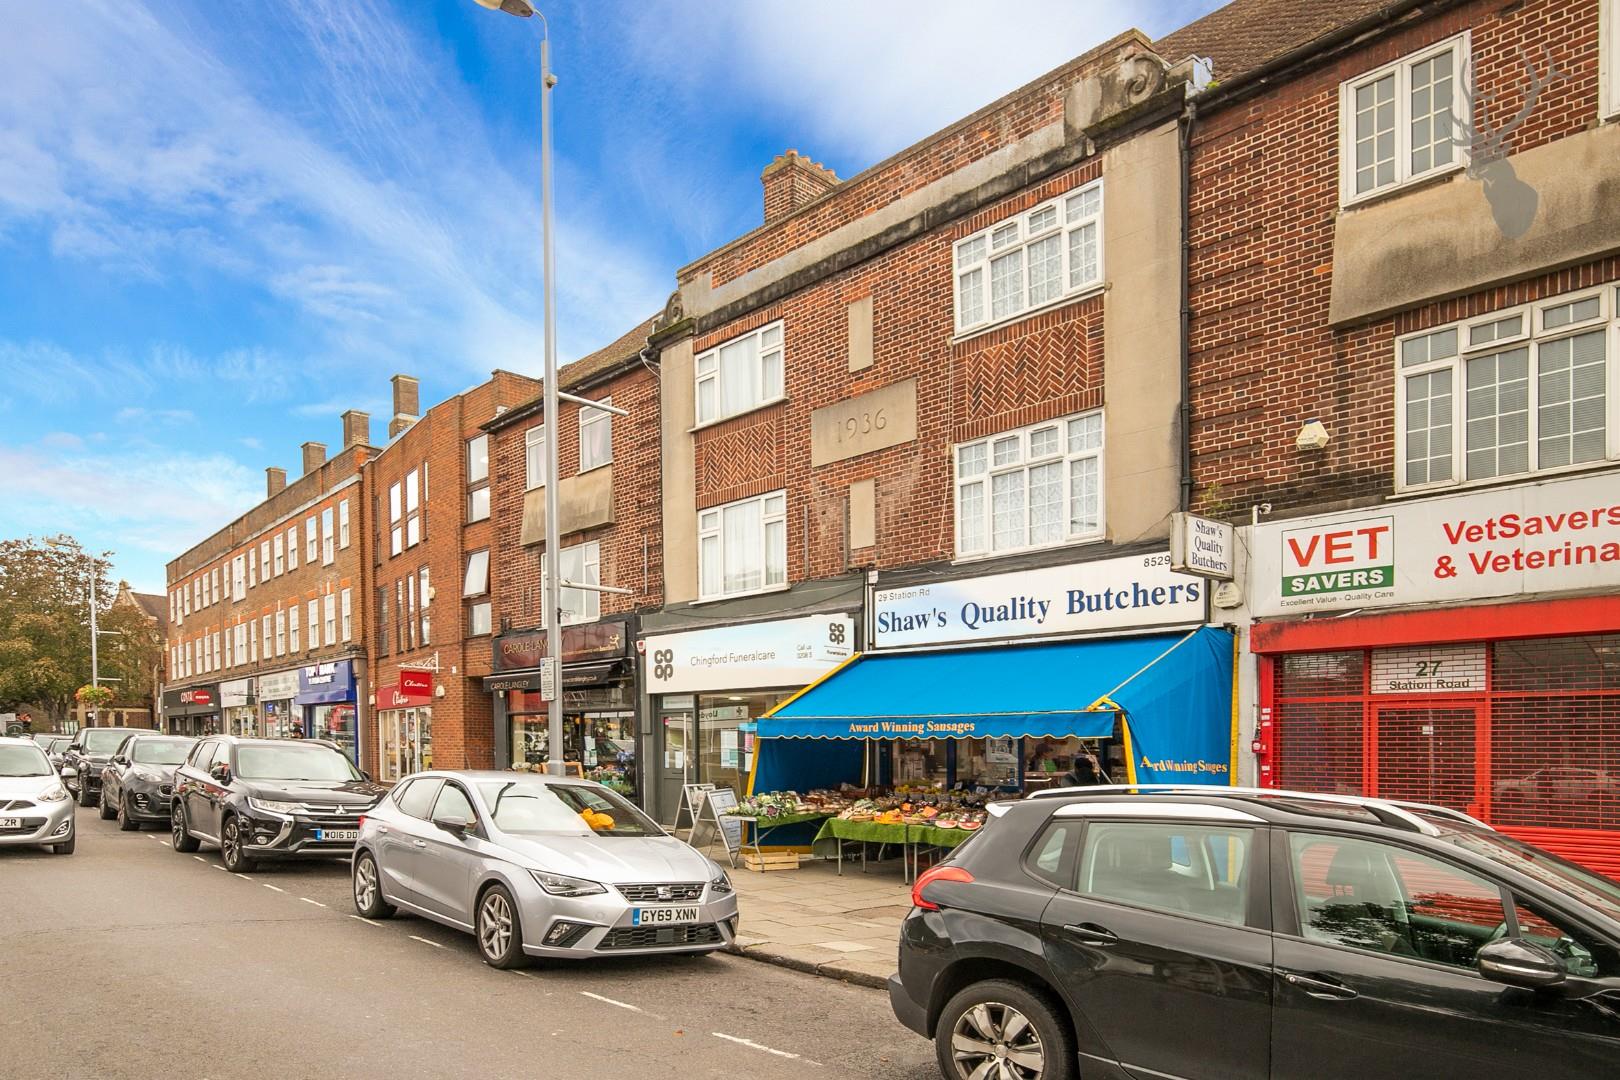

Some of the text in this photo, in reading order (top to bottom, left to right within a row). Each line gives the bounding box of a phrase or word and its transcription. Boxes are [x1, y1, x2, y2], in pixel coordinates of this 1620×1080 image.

[837, 408, 887, 443] 1936
[1195, 520, 1223, 538] Shaw's
[1443, 505, 1620, 545] VetSavers
[1194, 536, 1224, 557] Quality
[1288, 526, 1389, 568] VET
[1143, 555, 1170, 568] 8529
[1191, 552, 1228, 571] Butchers
[1434, 541, 1620, 579] & Veterina
[1292, 569, 1384, 593] SAVERS
[878, 588, 930, 602] 29 Station Rd
[1280, 598, 1314, 607] Excellent
[1315, 596, 1337, 604] Value
[1344, 593, 1372, 601] Quality
[877, 582, 1200, 634] Shaw's Quality Butchers
[690, 651, 776, 667] Chingford Funeralcare
[1416, 661, 1442, 676] 27
[1389, 679, 1470, 690] Station Road
[849, 720, 975, 734] Award Winning Sausages
[641, 908, 697, 922] GY69 XNN
